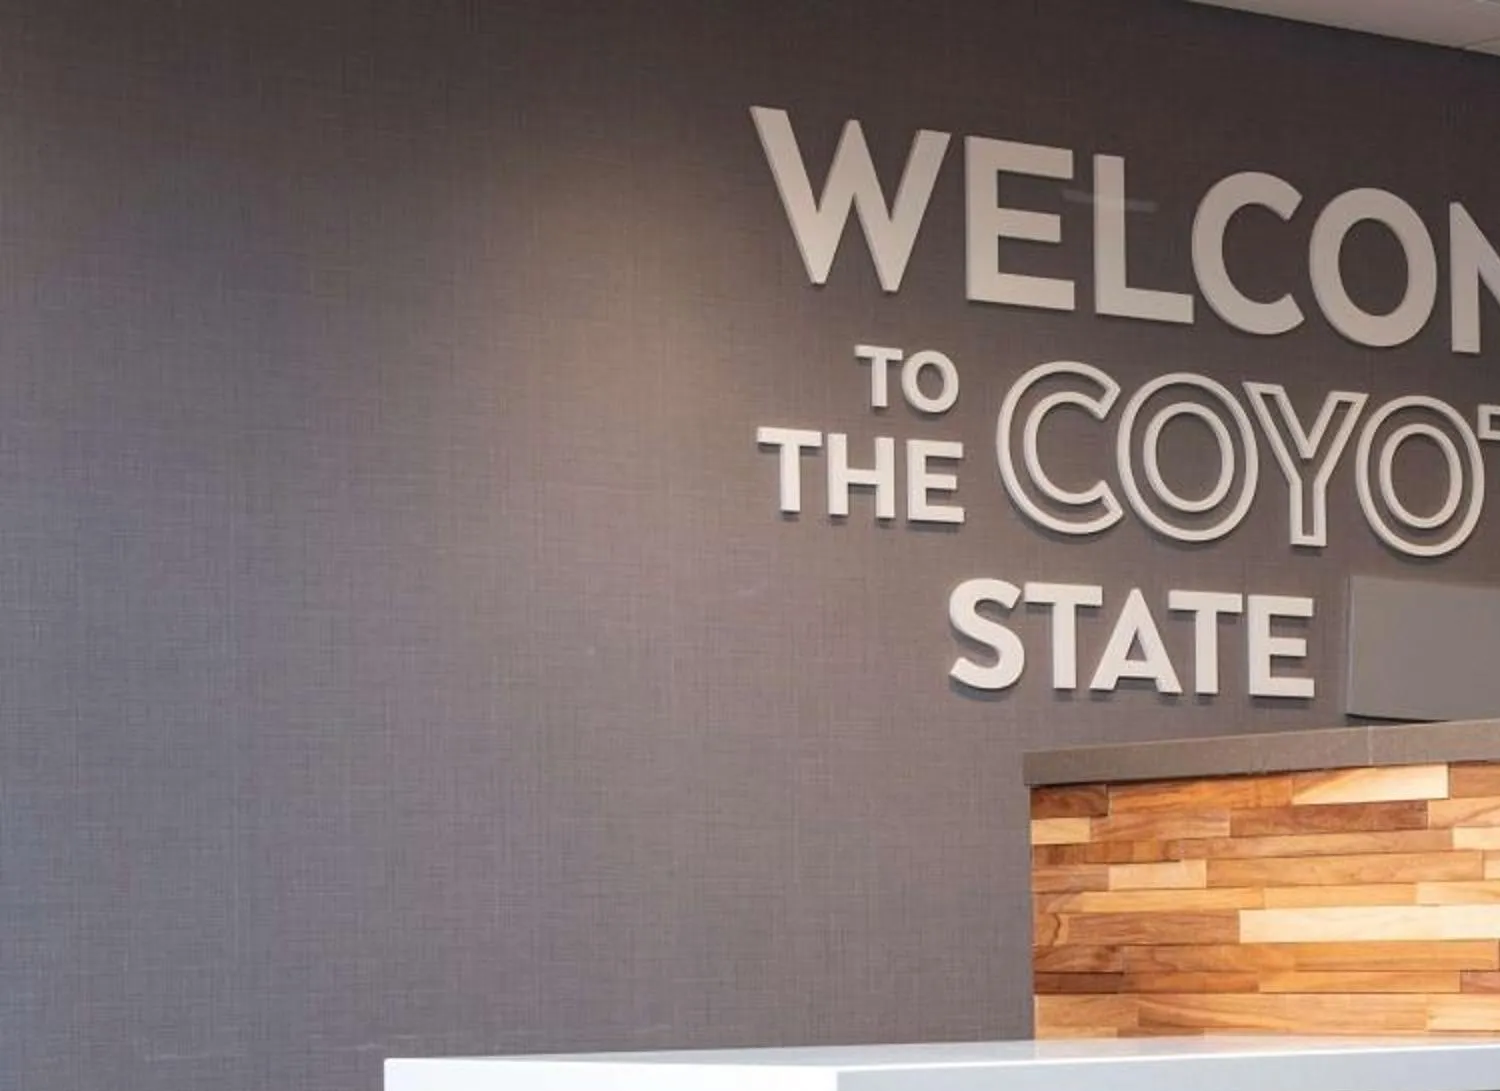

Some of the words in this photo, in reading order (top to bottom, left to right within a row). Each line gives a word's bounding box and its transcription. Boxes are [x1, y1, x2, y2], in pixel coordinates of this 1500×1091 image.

[854, 344, 959, 413] TO
[755, 425, 965, 523] THE
[948, 577, 1315, 698] STATE
